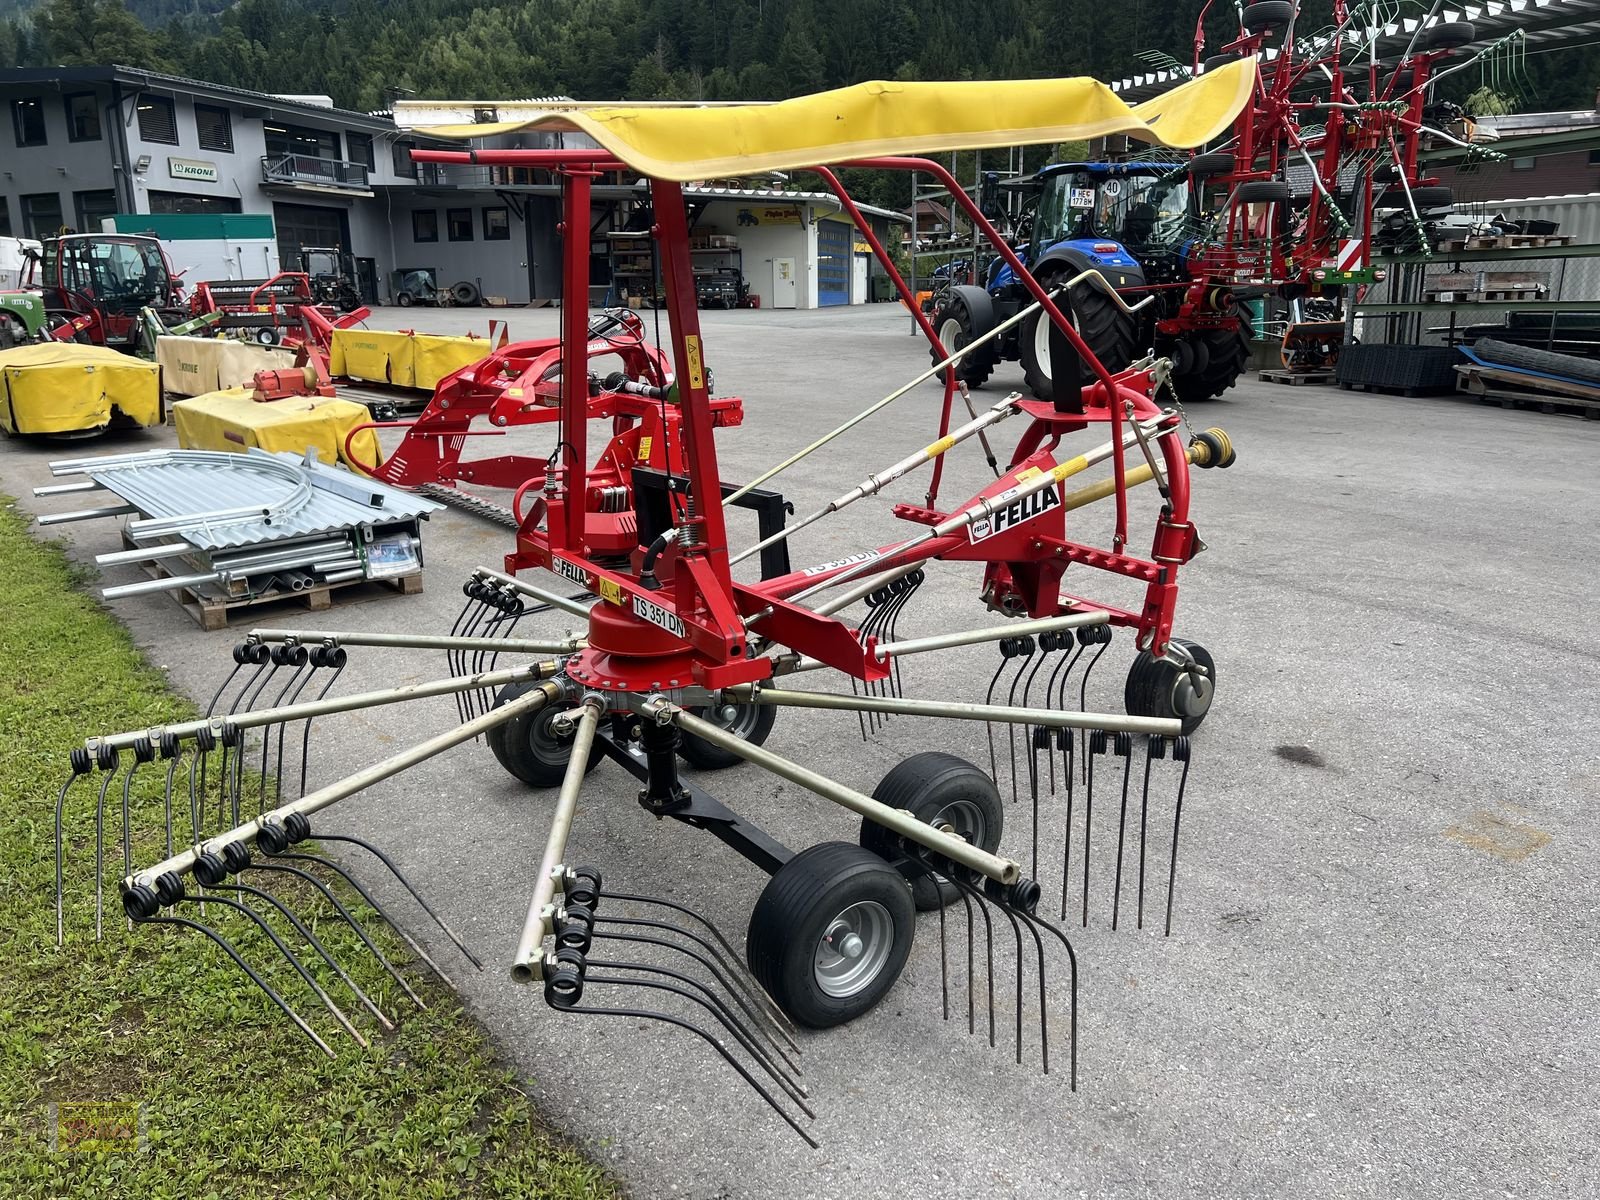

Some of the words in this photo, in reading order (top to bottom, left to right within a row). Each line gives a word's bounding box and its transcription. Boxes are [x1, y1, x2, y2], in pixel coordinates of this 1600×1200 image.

[185, 166, 215, 176] KRONE
[1106, 182, 1118, 194] 40
[995, 485, 1059, 533] FELLA
[974, 521, 990, 534] FELLA
[561, 560, 586, 586] FELLA
[634, 597, 647, 617] TS
[650, 605, 666, 627] 351
[669, 613, 684, 637] DN
